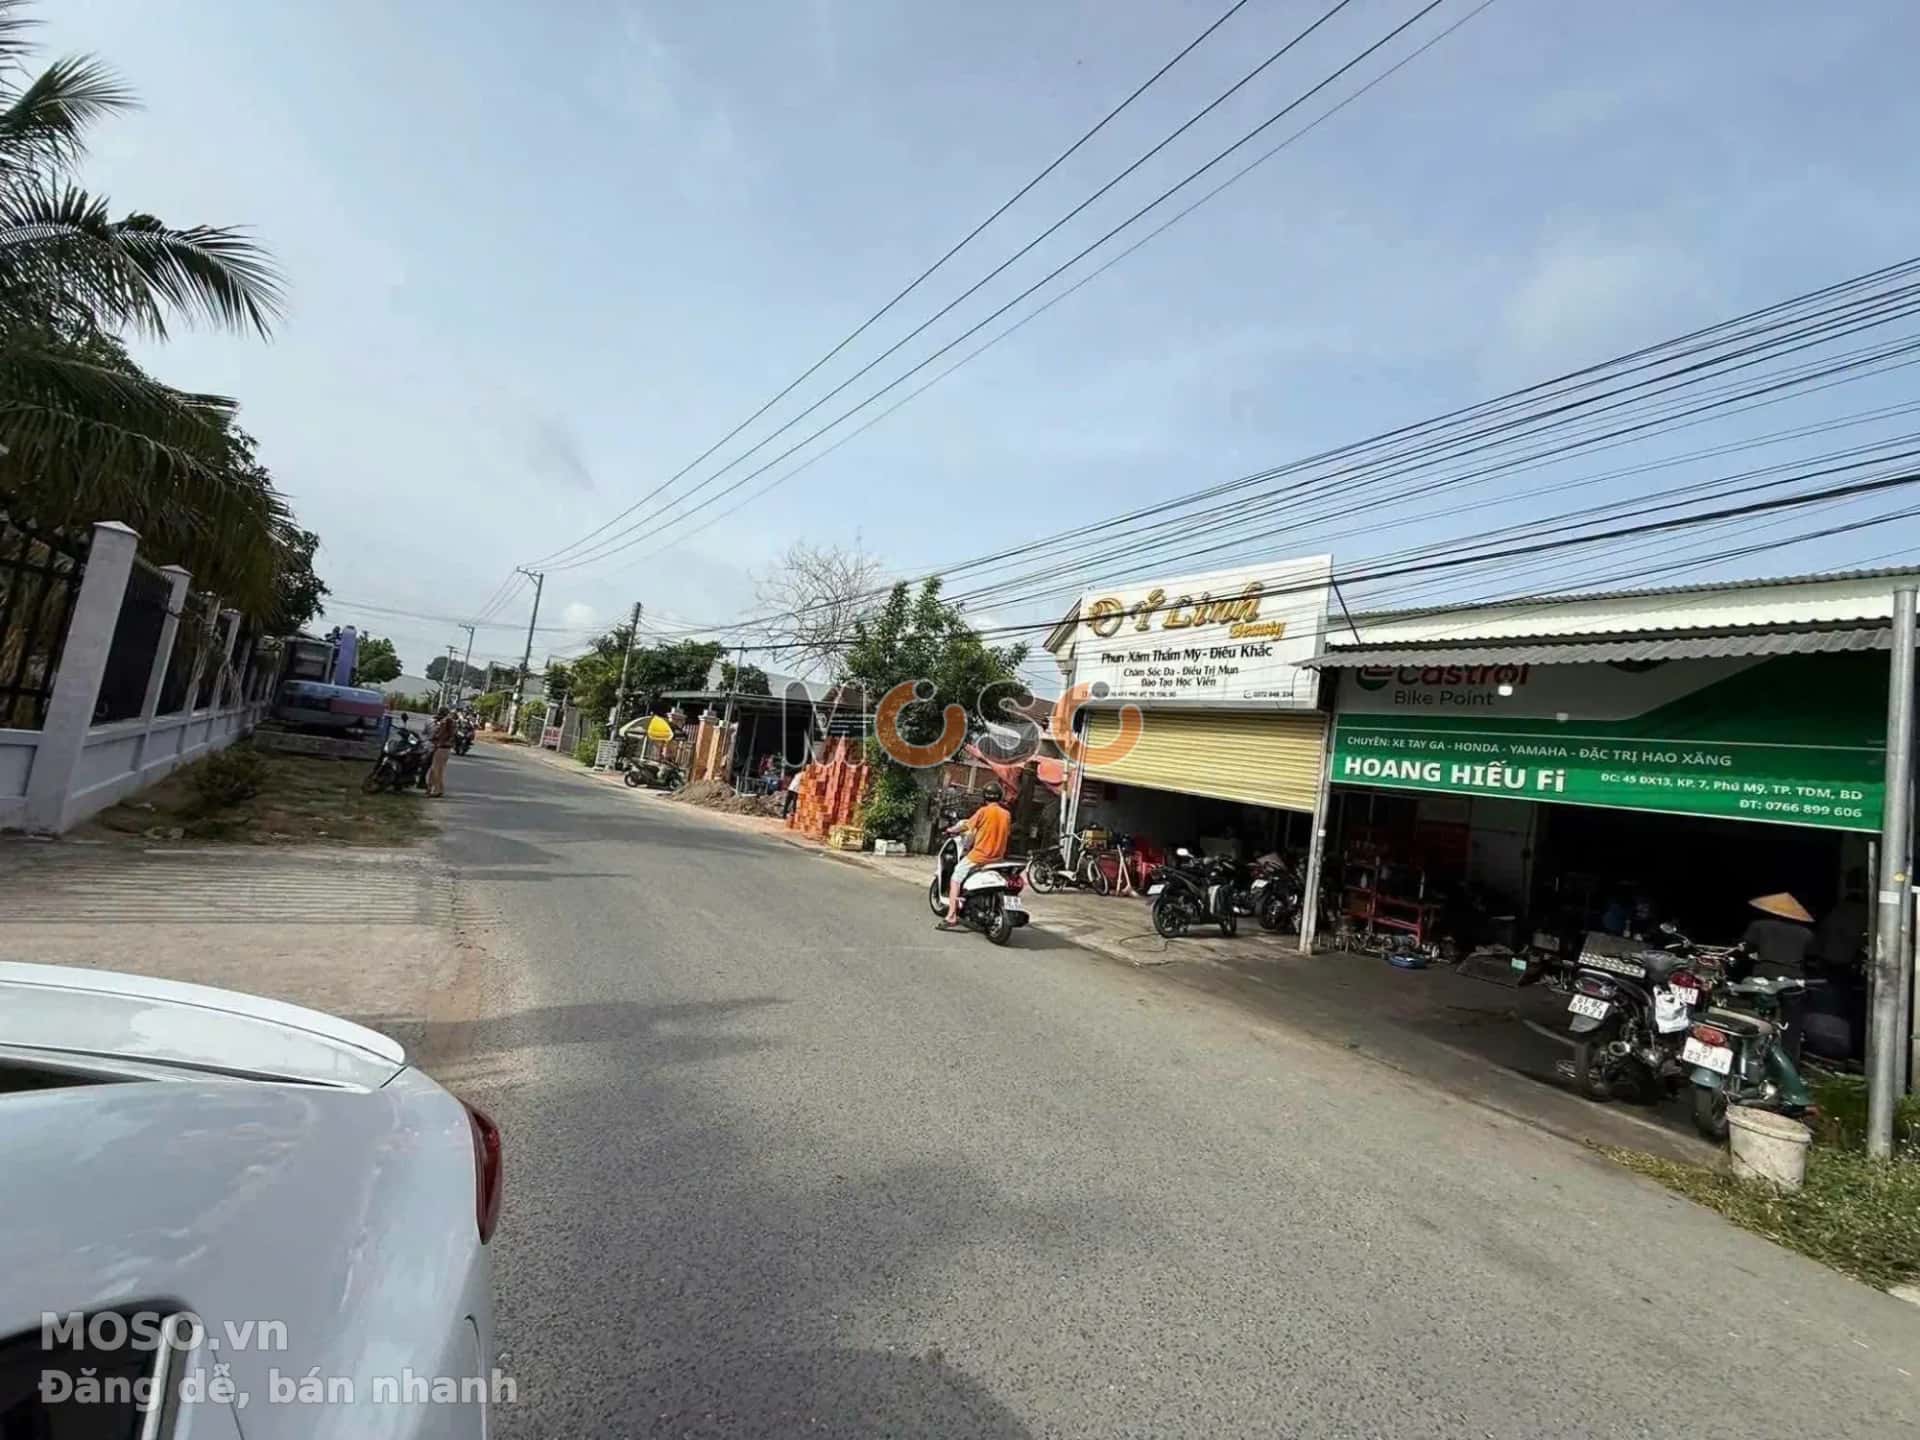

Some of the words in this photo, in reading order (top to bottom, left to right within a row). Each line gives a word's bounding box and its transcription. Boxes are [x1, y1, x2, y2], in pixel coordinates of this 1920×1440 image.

[1101, 653, 1125, 664] Phun
[1394, 689, 1433, 706] Bike
[1439, 689, 1495, 706] Point
[1392, 738, 1407, 748] XE
[1407, 739, 1427, 750] TAY
[1428, 741, 1445, 751] GA
[1454, 742, 1500, 753] HONDA
[1510, 744, 1568, 757] YAMAHA
[1579, 746, 1609, 761] ĐẶC
[1613, 749, 1638, 763] TRỊ
[1642, 751, 1678, 763] HAO
[1681, 750, 1733, 766] XĂNG
[1343, 756, 1442, 783] HOANG
[1450, 760, 1527, 790] HIẾU
[1536, 768, 1566, 793] Fi
[1771, 784, 1793, 796] TP.
[1765, 801, 1800, 813] 0766
[1802, 804, 1831, 816] 899
[1833, 806, 1863, 818] 606
